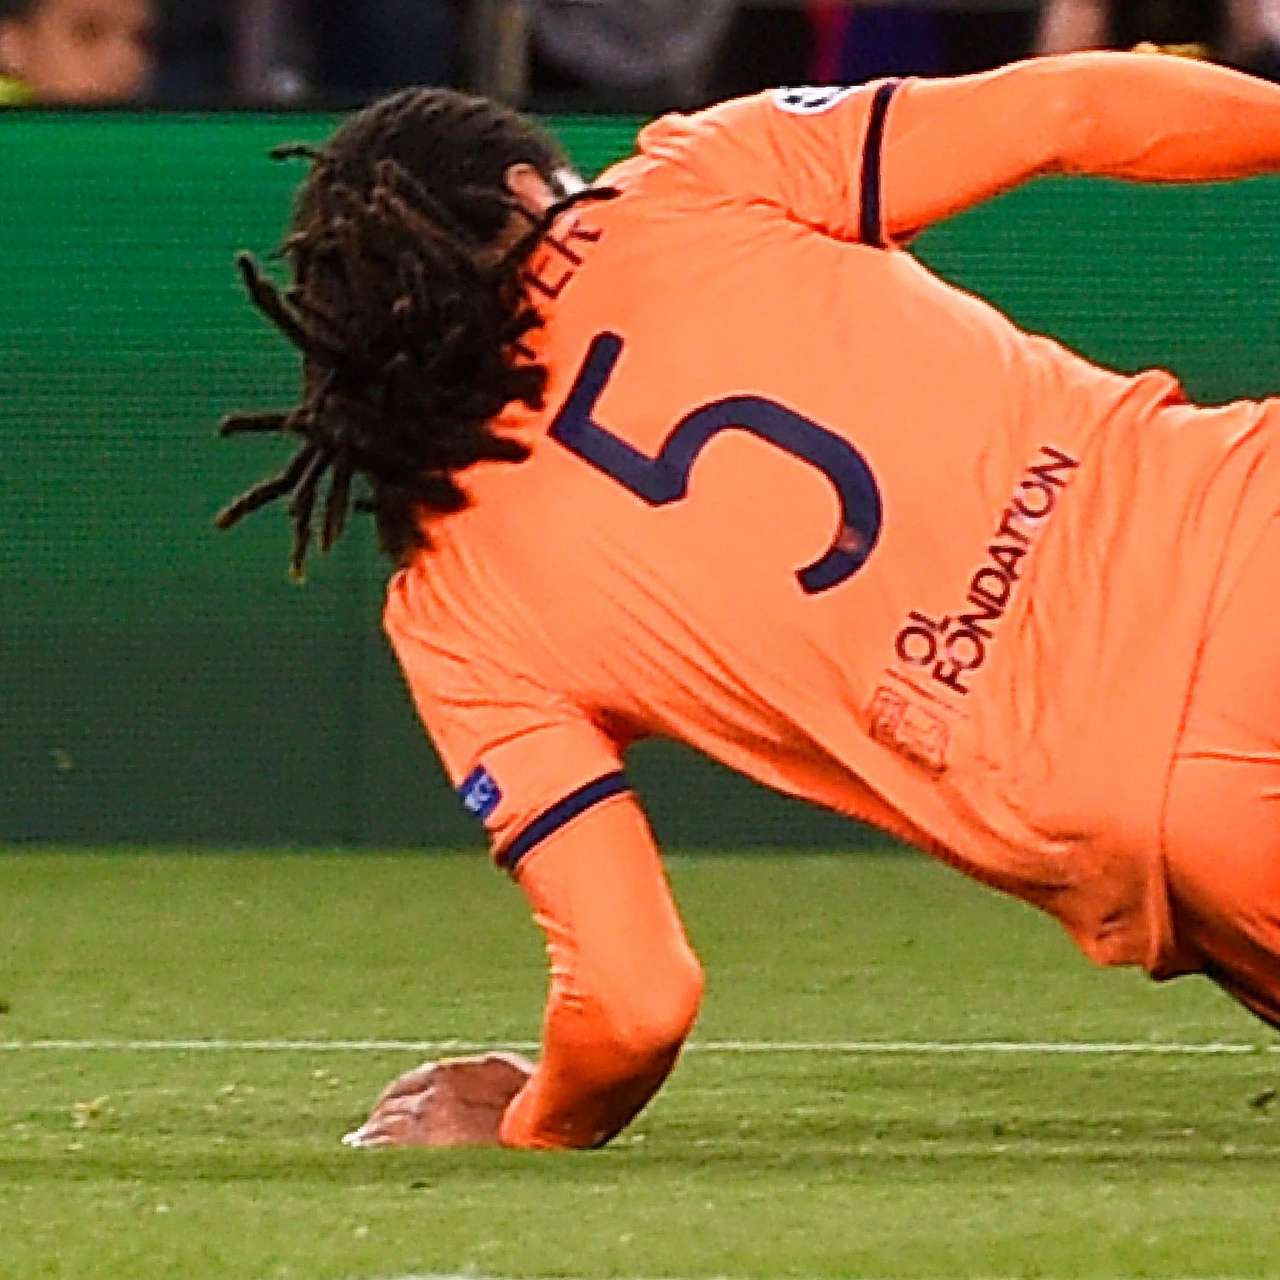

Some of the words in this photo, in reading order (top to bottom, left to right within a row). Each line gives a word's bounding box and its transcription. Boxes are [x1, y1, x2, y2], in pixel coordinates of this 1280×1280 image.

[547, 330, 883, 595] 5
[931, 446, 1080, 697] FONDATON
[895, 610, 951, 666] OL
